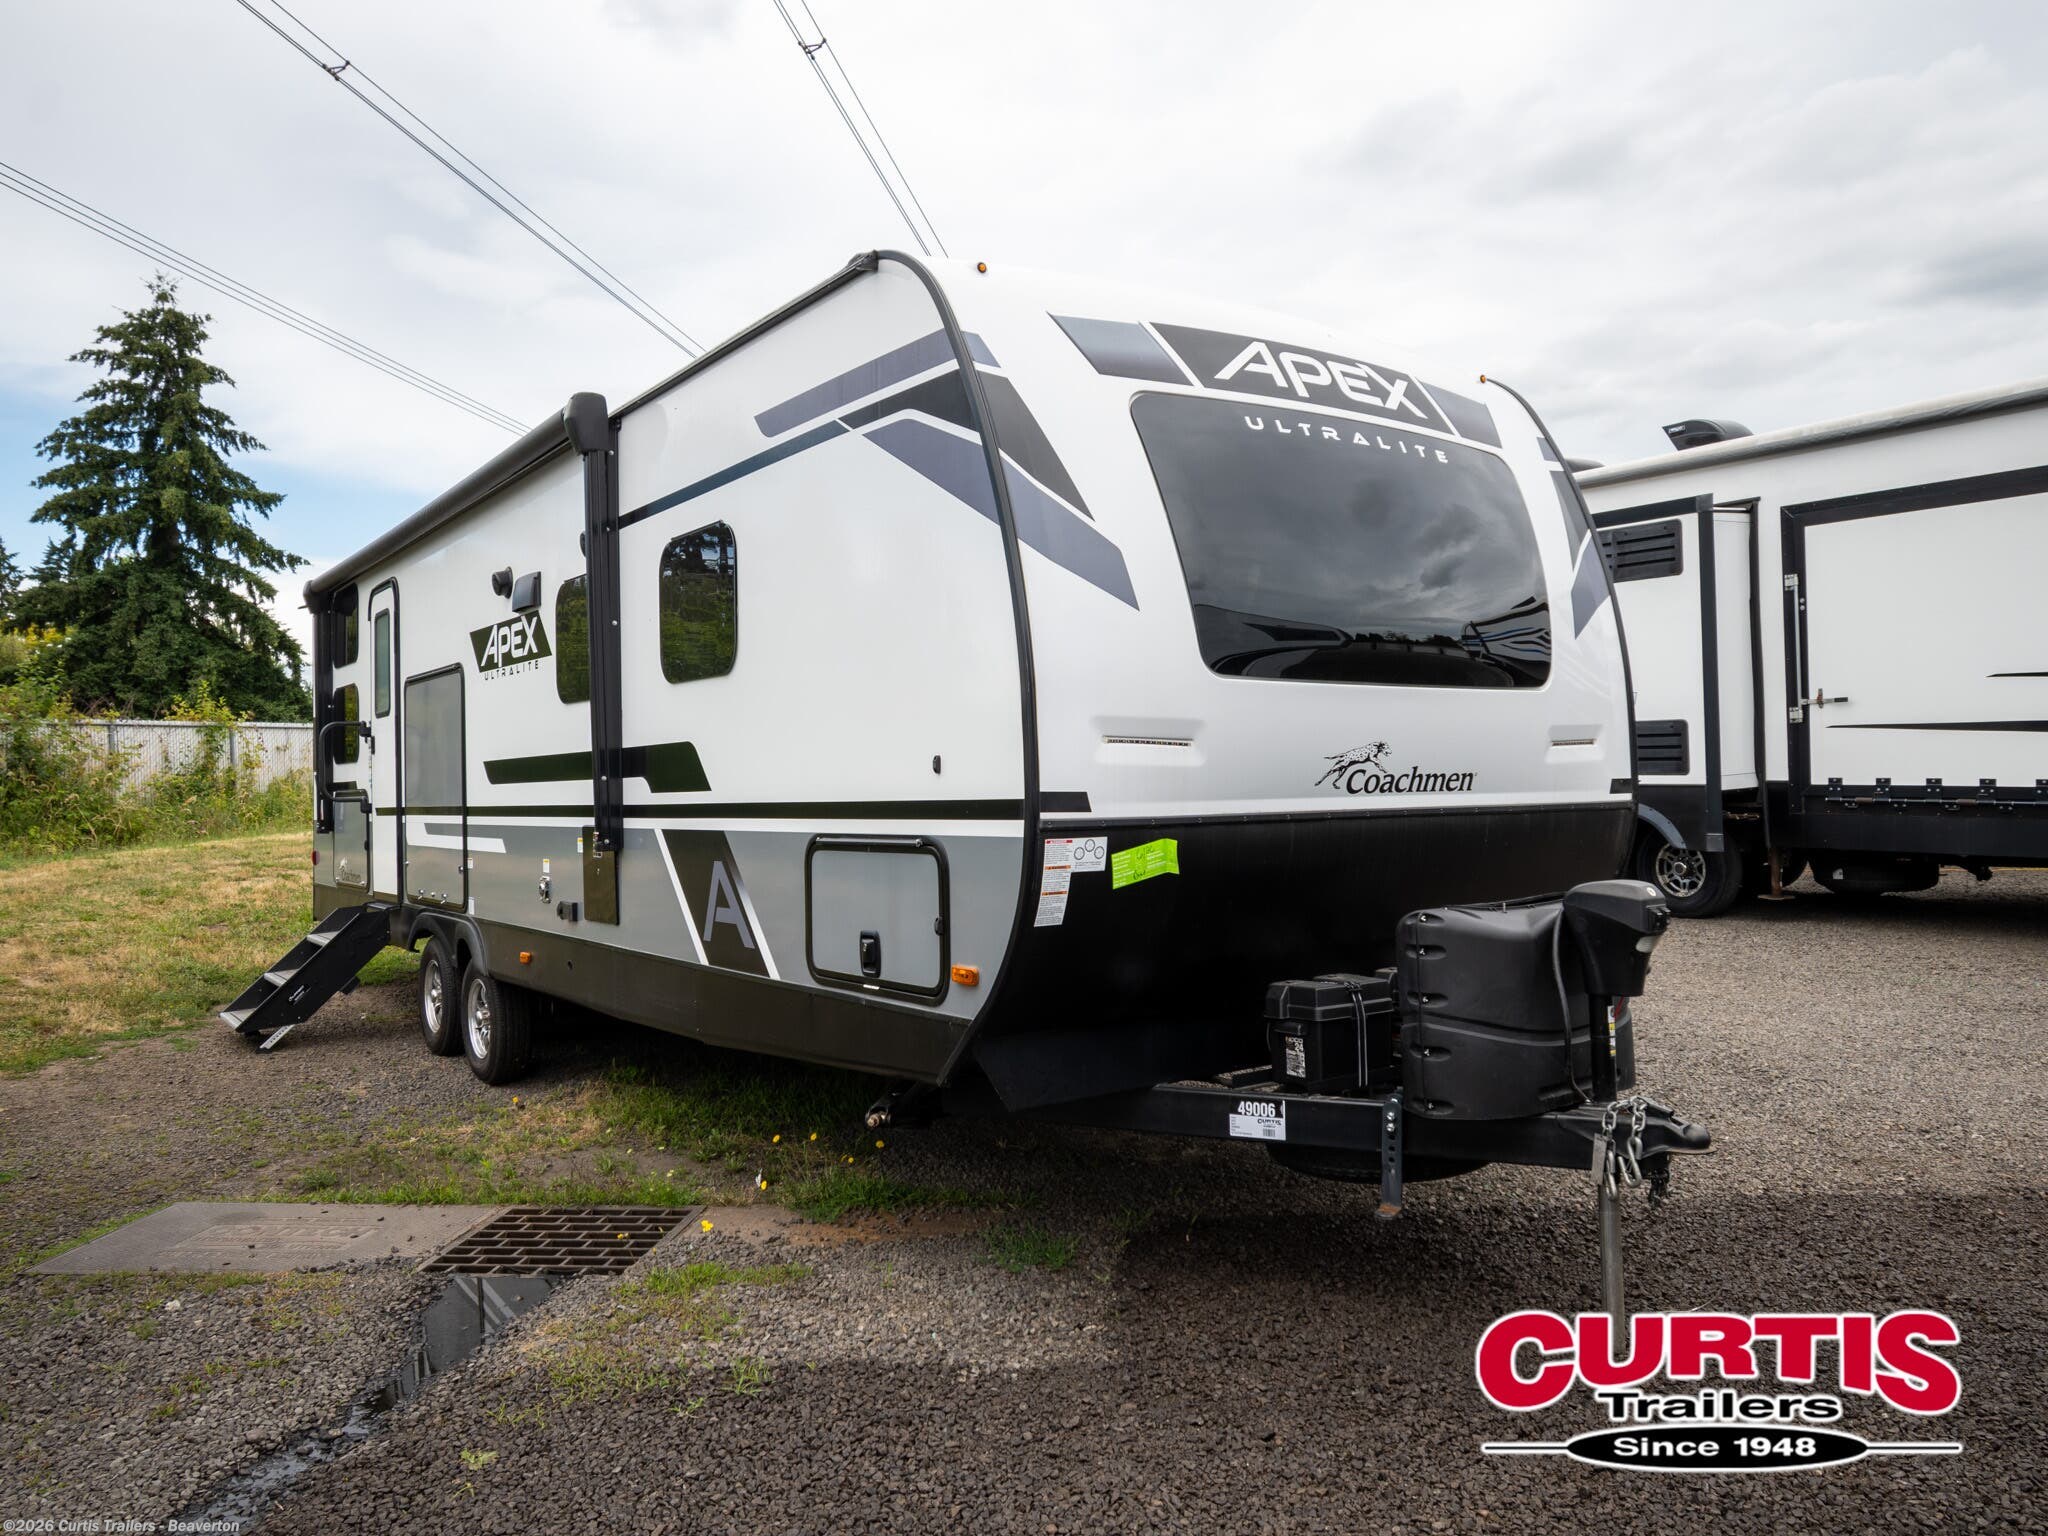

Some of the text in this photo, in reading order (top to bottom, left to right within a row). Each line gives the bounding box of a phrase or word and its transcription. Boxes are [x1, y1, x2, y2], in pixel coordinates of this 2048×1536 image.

[1213, 341, 1429, 419] APEX
[1244, 415, 1449, 464] ULTRALITE
[480, 615, 538, 668] APEX
[484, 660, 539, 680] ULTRALITE
[1346, 765, 1474, 794] Coachmen
[1237, 1100, 1276, 1118] 49006
